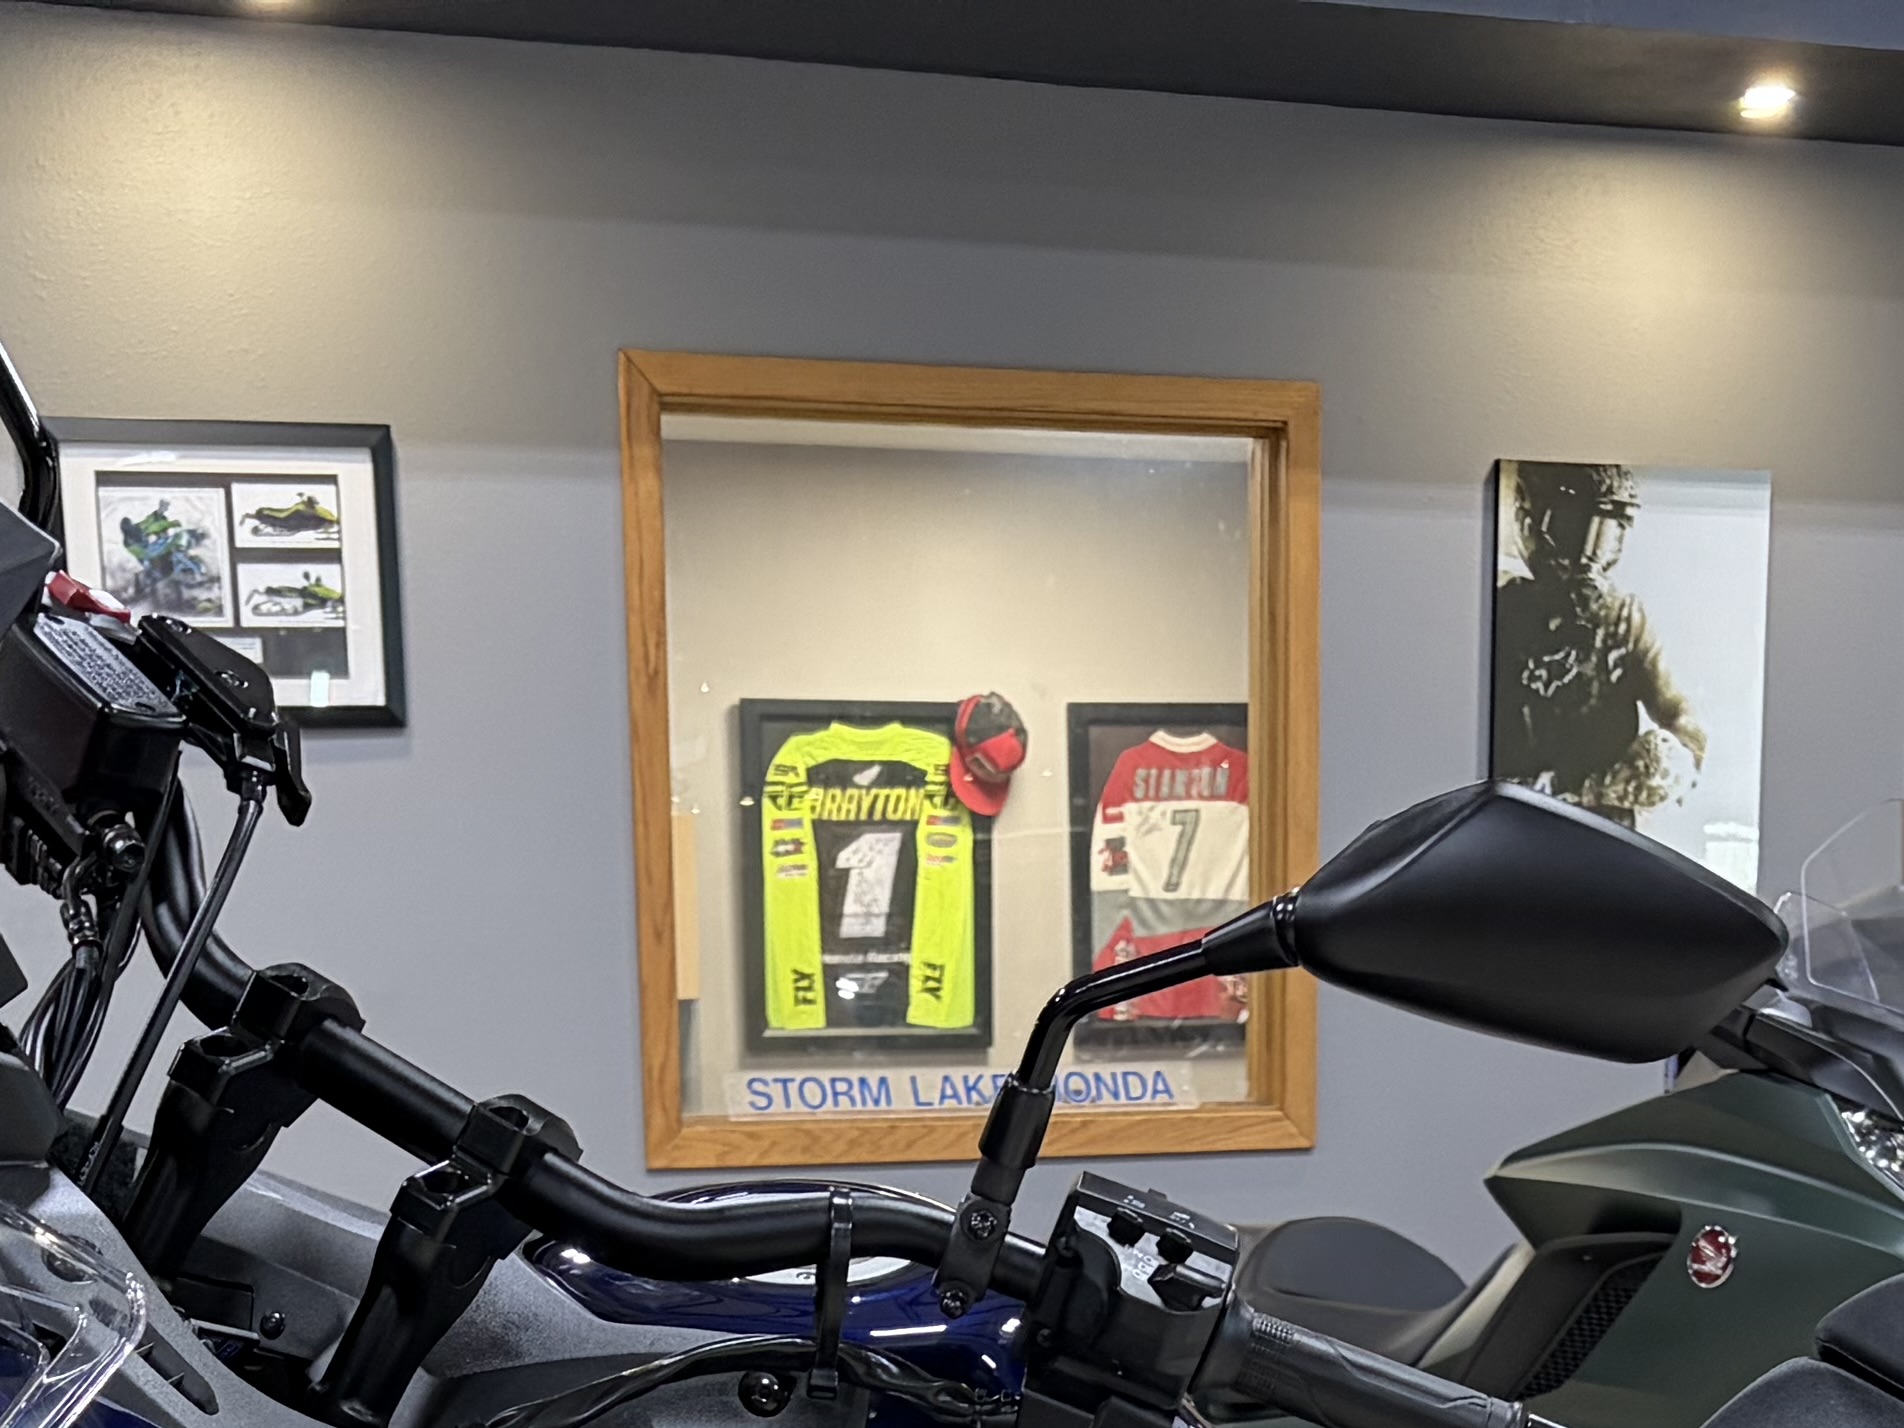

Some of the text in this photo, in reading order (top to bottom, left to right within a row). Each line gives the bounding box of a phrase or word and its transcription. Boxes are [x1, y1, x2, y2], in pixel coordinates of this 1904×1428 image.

[834, 832, 903, 938] 1
[1162, 808, 1201, 893] 7
[747, 1076, 893, 1112] STORM
